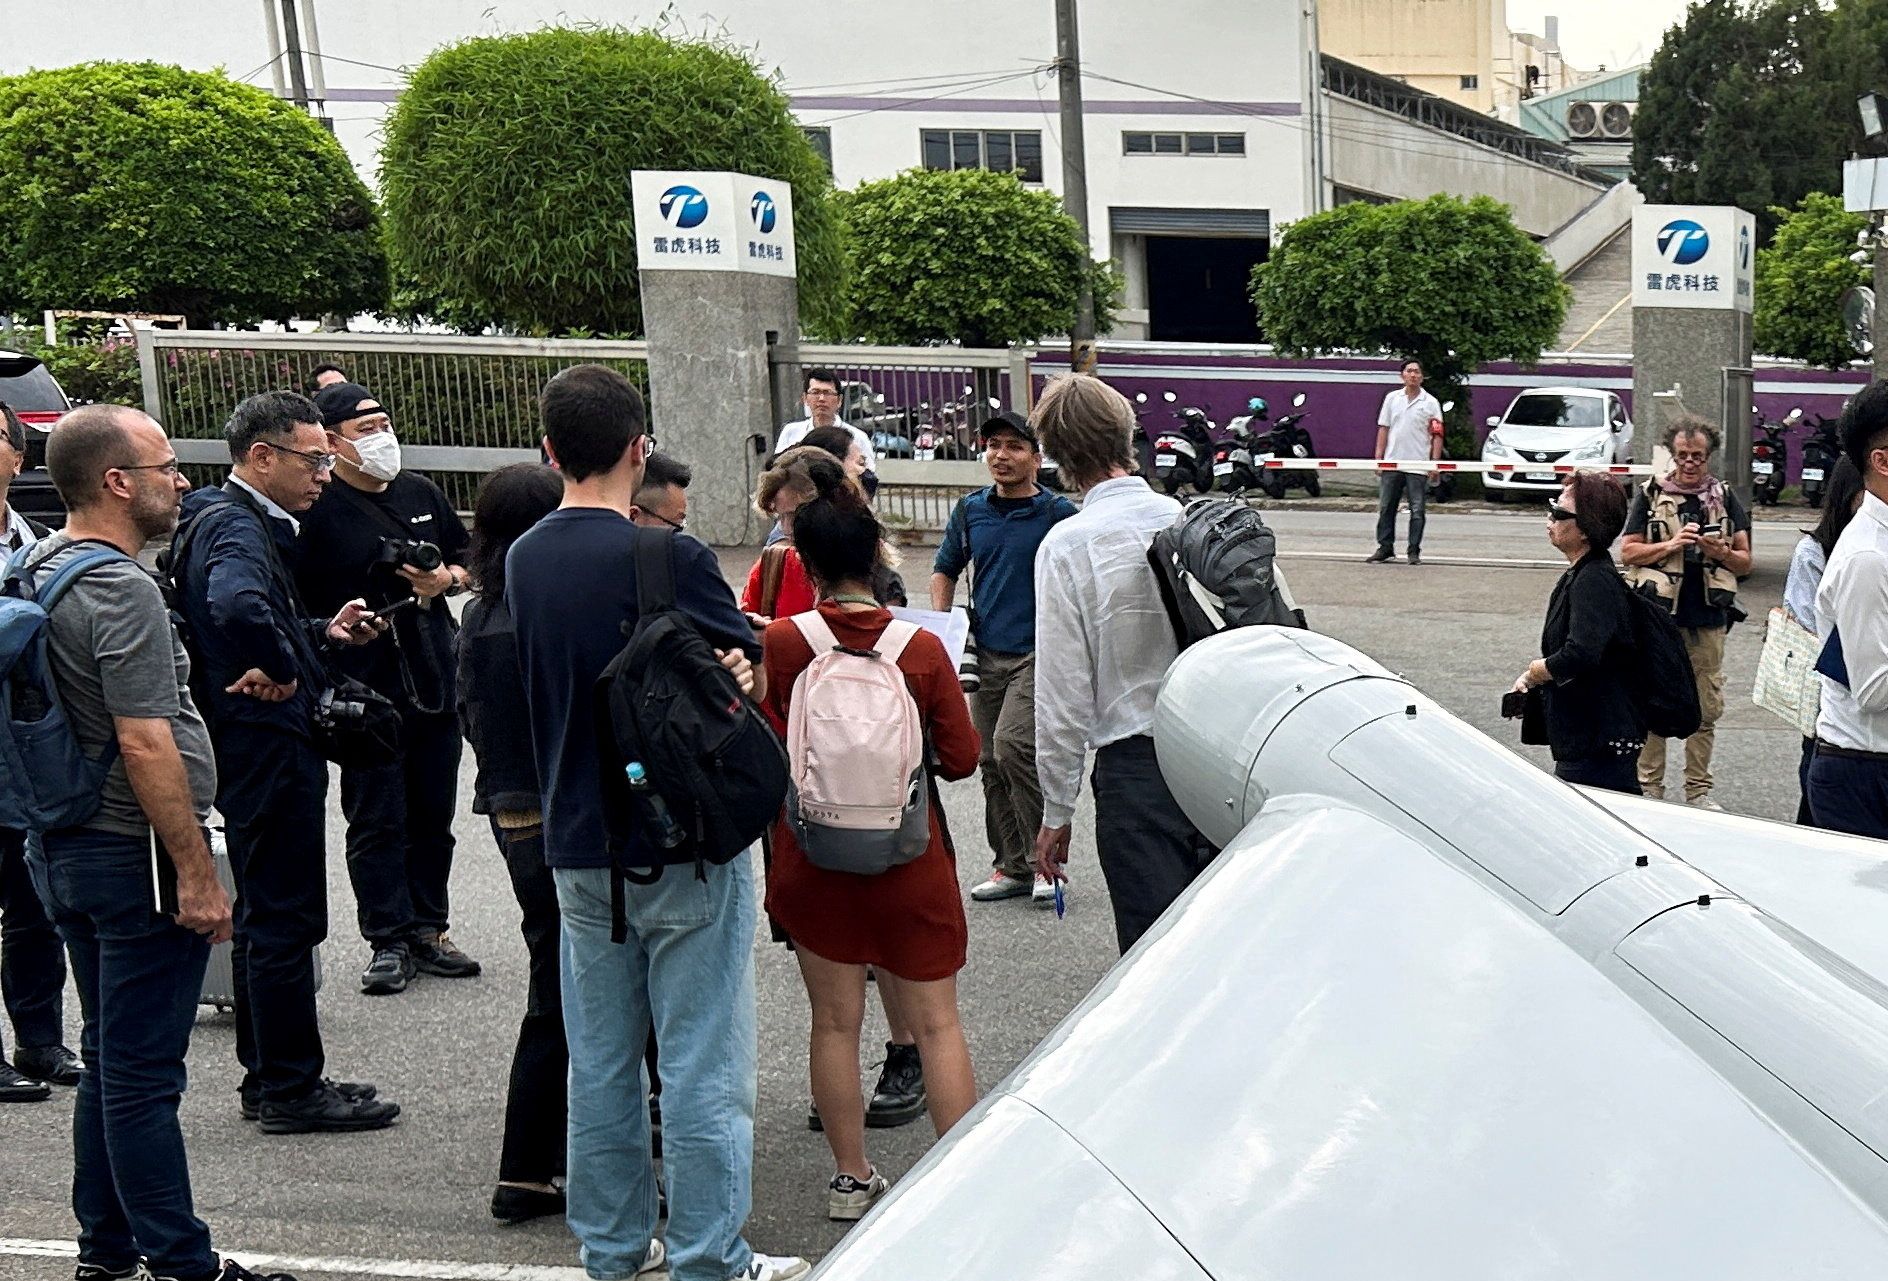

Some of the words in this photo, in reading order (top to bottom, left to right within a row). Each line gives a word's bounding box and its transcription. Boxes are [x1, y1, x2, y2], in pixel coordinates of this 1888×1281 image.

[653, 236, 721, 255] 雷虎科技
[749, 241, 784, 261] 雷虎科技
[1647, 273, 1720, 291] 雷虎科技
